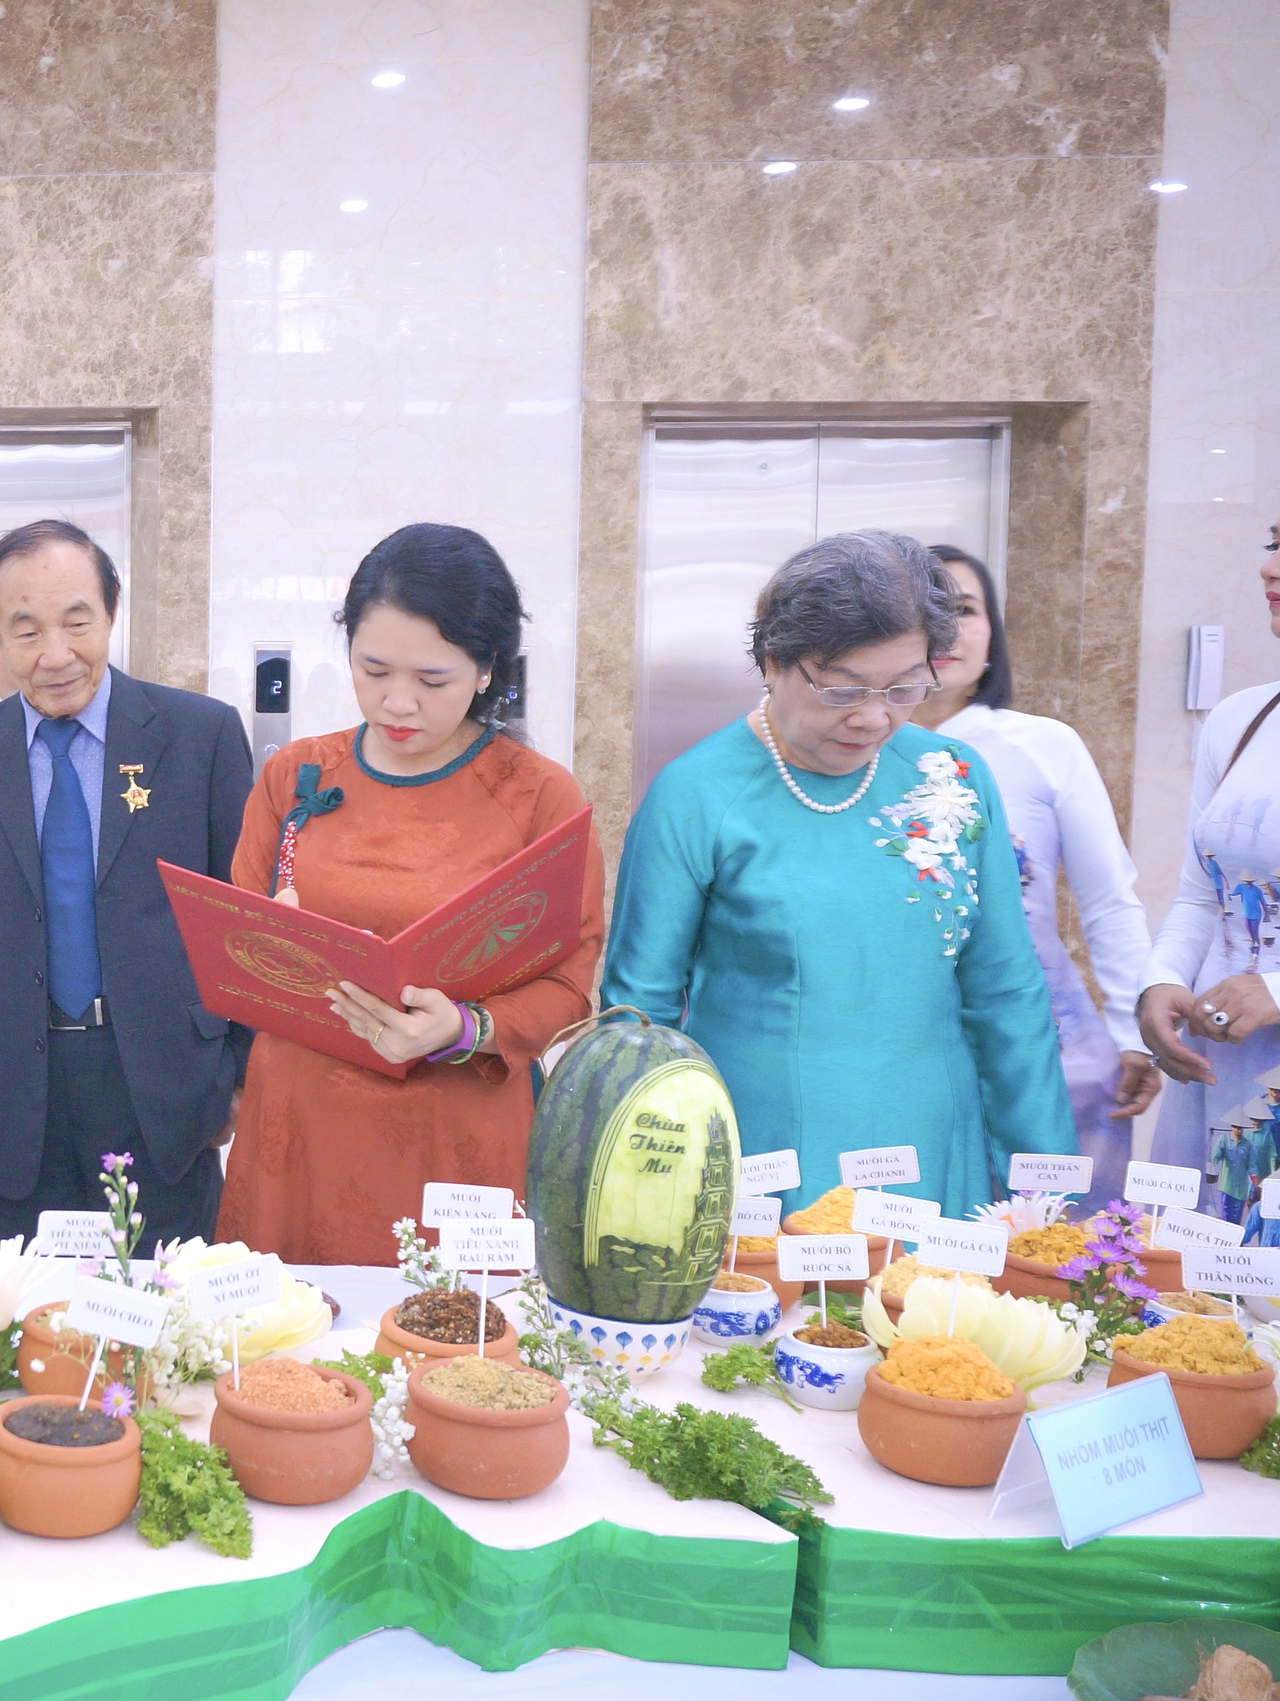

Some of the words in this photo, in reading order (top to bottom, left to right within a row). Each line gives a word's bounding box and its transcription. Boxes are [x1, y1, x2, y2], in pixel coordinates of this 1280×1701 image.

[272, 680, 282, 694] 2
[635, 1113, 686, 1132] Chùa
[629, 1133, 687, 1154] Thiên
[856, 1156, 884, 1168] MUỐI
[885, 1153, 900, 1164] GÀ
[1020, 1160, 1050, 1172] MUỐI
[746, 1171, 769, 1184] NGŨ
[855, 1169, 869, 1181] LÁ
[870, 1167, 906, 1180] CHANH
[1037, 1172, 1061, 1182] CAY
[1132, 1176, 1158, 1189] MUỐI
[1159, 1179, 1173, 1191] CÁ
[451, 1192, 481, 1204] MUỐI
[464, 1208, 497, 1219] VÀNG
[883, 1202, 913, 1216] MUỐI
[65, 1217, 95, 1228] MUỐI
[753, 1211, 776, 1223] CAY
[871, 1216, 886, 1228] GÀ
[470, 1225, 502, 1236] MUỐI
[1166, 1223, 1195, 1238] MUỐI
[1196, 1232, 1211, 1244] CÁ
[54, 1238, 72, 1250] ỚT
[74, 1238, 101, 1250] XIÊM
[454, 1237, 481, 1249] TIÊU
[486, 1239, 519, 1250] XANH
[801, 1243, 835, 1255] MUỐI
[836, 1243, 852, 1255] BÒ
[926, 1233, 957, 1249] MUỐI
[959, 1239, 976, 1252] GÀ
[978, 1242, 1003, 1256] CAY
[459, 1253, 484, 1263] RAU
[487, 1251, 515, 1263] RĂM
[1215, 1254, 1251, 1266] MUỐI
[208, 1273, 240, 1288] MUỐI
[245, 1267, 261, 1280] ỚT
[1236, 1273, 1274, 1286] BÔNG
[229, 1285, 261, 1302] MUỘI
[84, 1299, 117, 1317] MUỐI
[1057, 1438, 1101, 1472] NHÓM
[1102, 1424, 1140, 1455] MUỐI
[1140, 1416, 1170, 1441] THỊT
[1102, 1466, 1114, 1486] 8
[1114, 1455, 1148, 1483] MÓN
